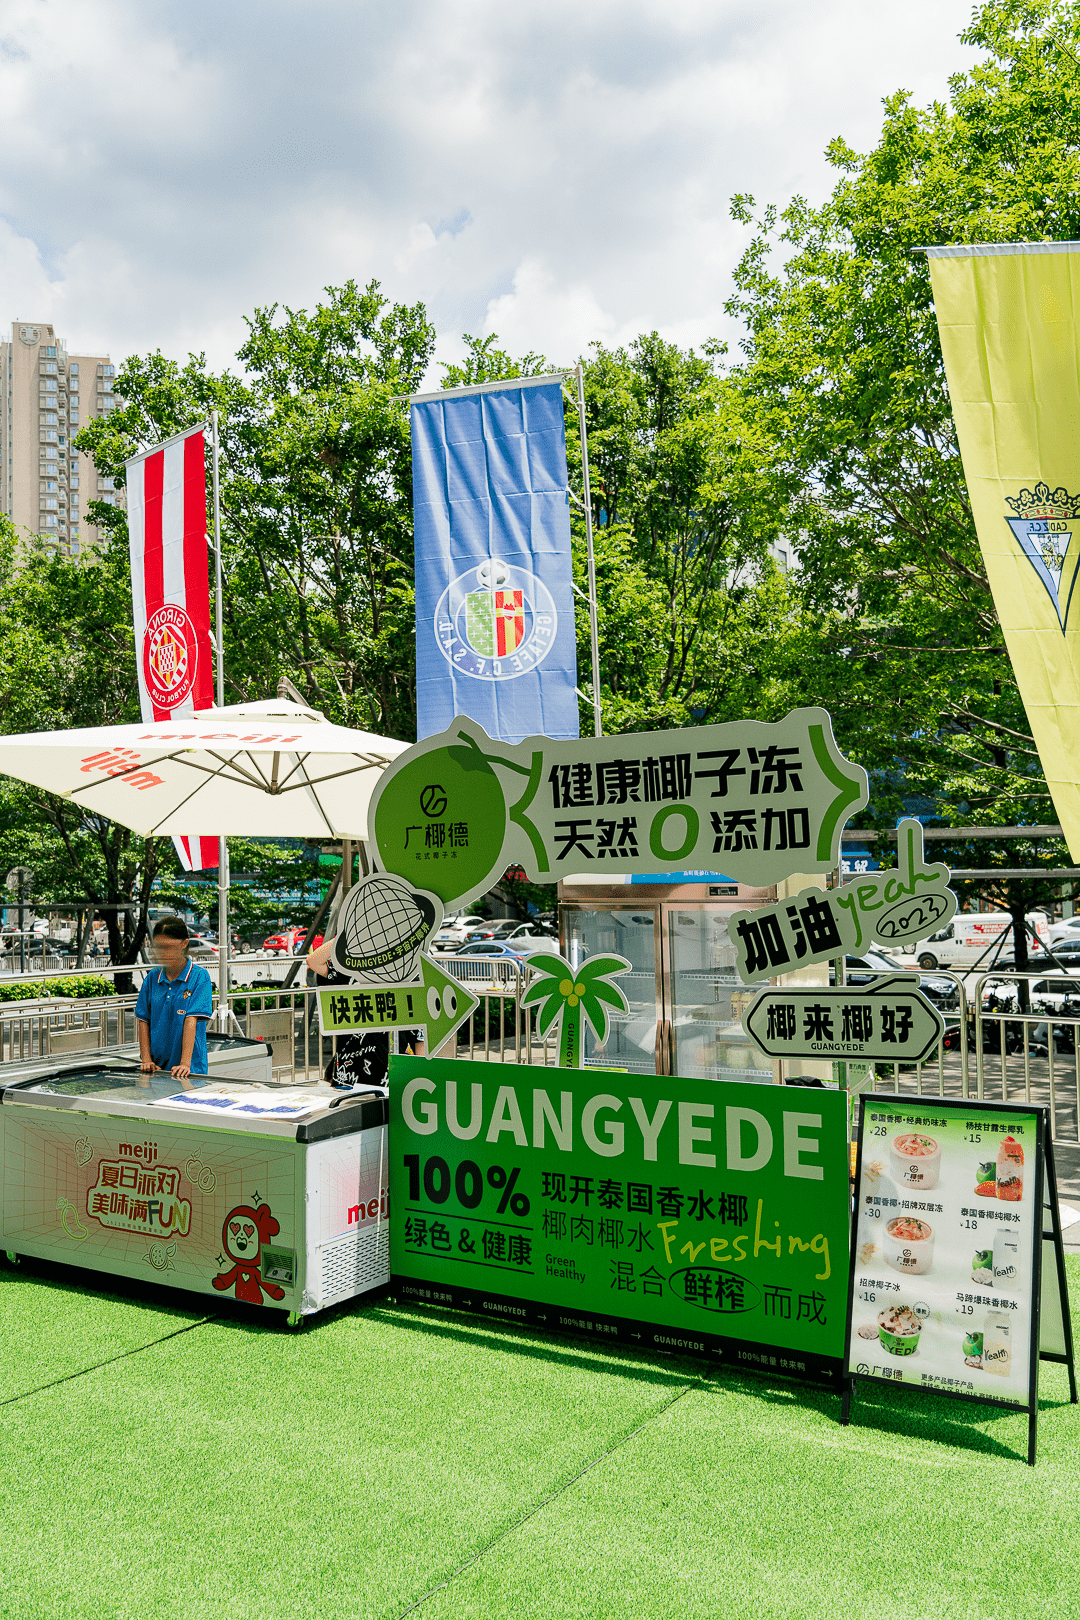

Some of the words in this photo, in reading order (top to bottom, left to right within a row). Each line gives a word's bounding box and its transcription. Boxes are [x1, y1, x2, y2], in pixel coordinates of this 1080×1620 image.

[137, 733, 303, 744] meiji
[547, 745, 803, 810] 健康椰子冻
[403, 821, 469, 850] 广椰德
[736, 896, 842, 975] 加油
[880, 896, 941, 937] 2023
[766, 1003, 914, 1043] 椰来椰好
[810, 1042, 865, 1052] GUANGYEDE
[401, 1077, 825, 1181] GUANGYEDE
[965, 1121, 1024, 1134] 杨枝甘露生椰乳
[118, 1141, 158, 1164] meiji
[101, 1165, 176, 1197] 夏日派对
[403, 1153, 531, 1218] 100%
[541, 1170, 749, 1227] 现开泰国香水椰
[92, 1191, 188, 1232] 美味满FUN
[541, 1208, 656, 1254] 椰肉椰水
[656, 1198, 831, 1280] Freshing
[545, 1253, 576, 1269] Green
[545, 1264, 587, 1283] Healthy
[859, 1277, 901, 1292] 招牌椰子冰
[482, 1301, 527, 1316] GUANGYEDE
[559, 1316, 594, 1331] 100%能量
[595, 1323, 618, 1336] 快来鸭
[653, 1334, 705, 1352] GUANGYEDE
[737, 1350, 777, 1367] 100%能量
[780, 1358, 806, 1372] 快来鸭
[871, 1365, 903, 1381] 广椰德
